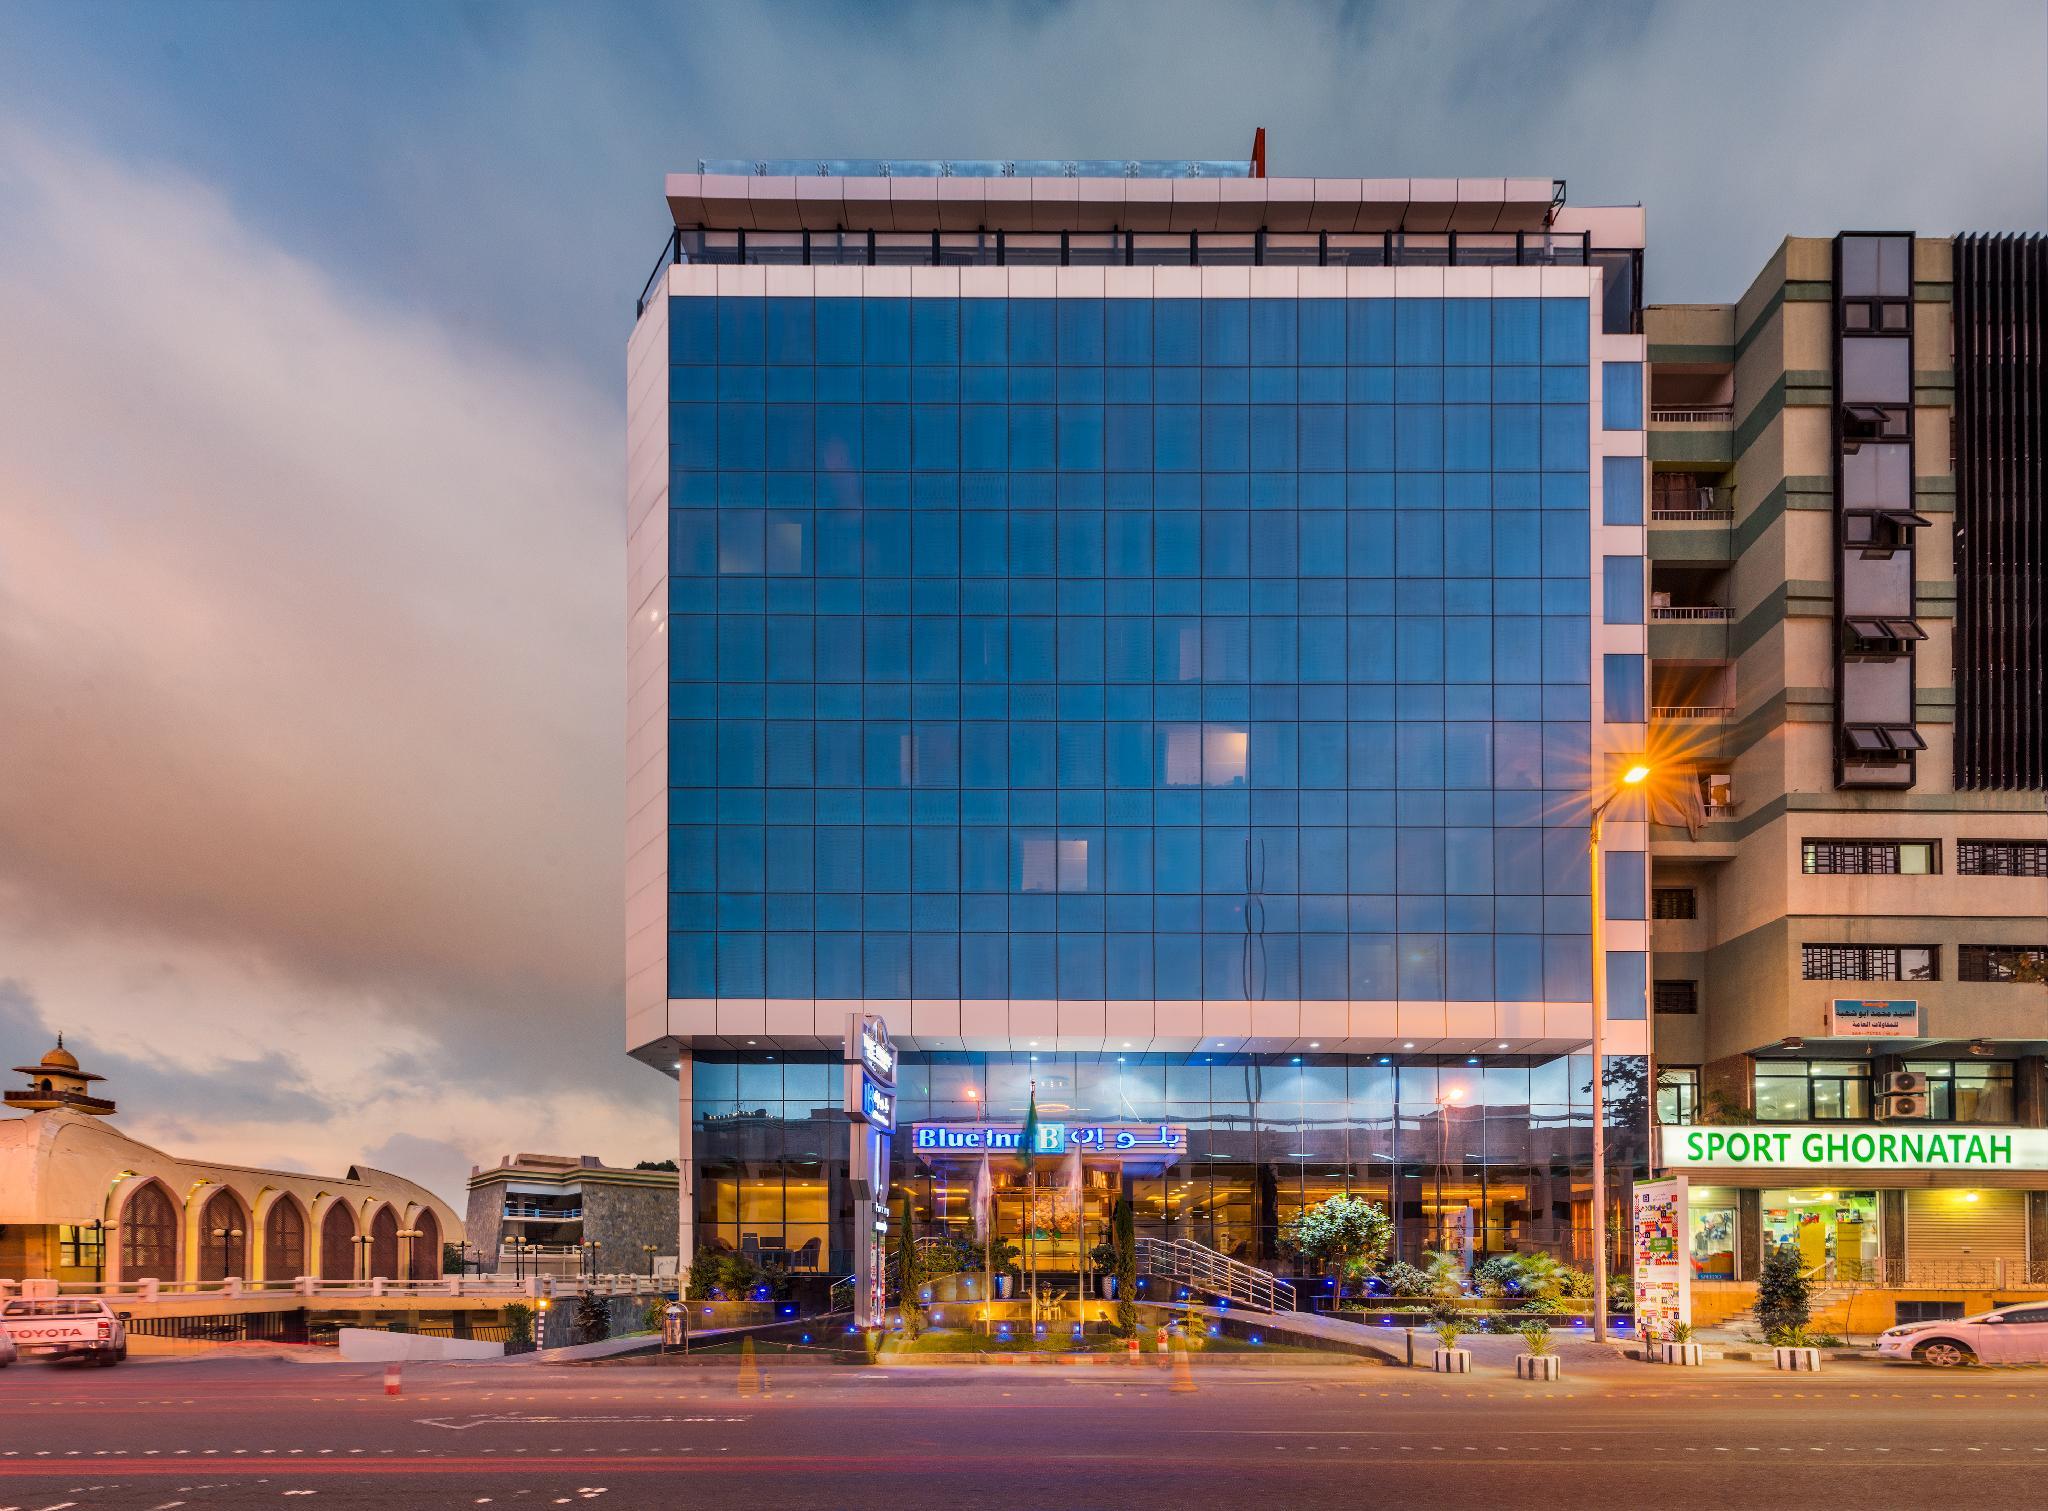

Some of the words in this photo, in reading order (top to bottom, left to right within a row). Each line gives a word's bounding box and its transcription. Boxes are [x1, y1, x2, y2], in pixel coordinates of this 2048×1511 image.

[918, 1127, 980, 1148] Blue
[1039, 1127, 1059, 1150] B
[1687, 1131, 1792, 1162] SPORT
[1802, 1132, 2013, 1164] GHORNATAH
[7, 1328, 83, 1339] TOYOTA
